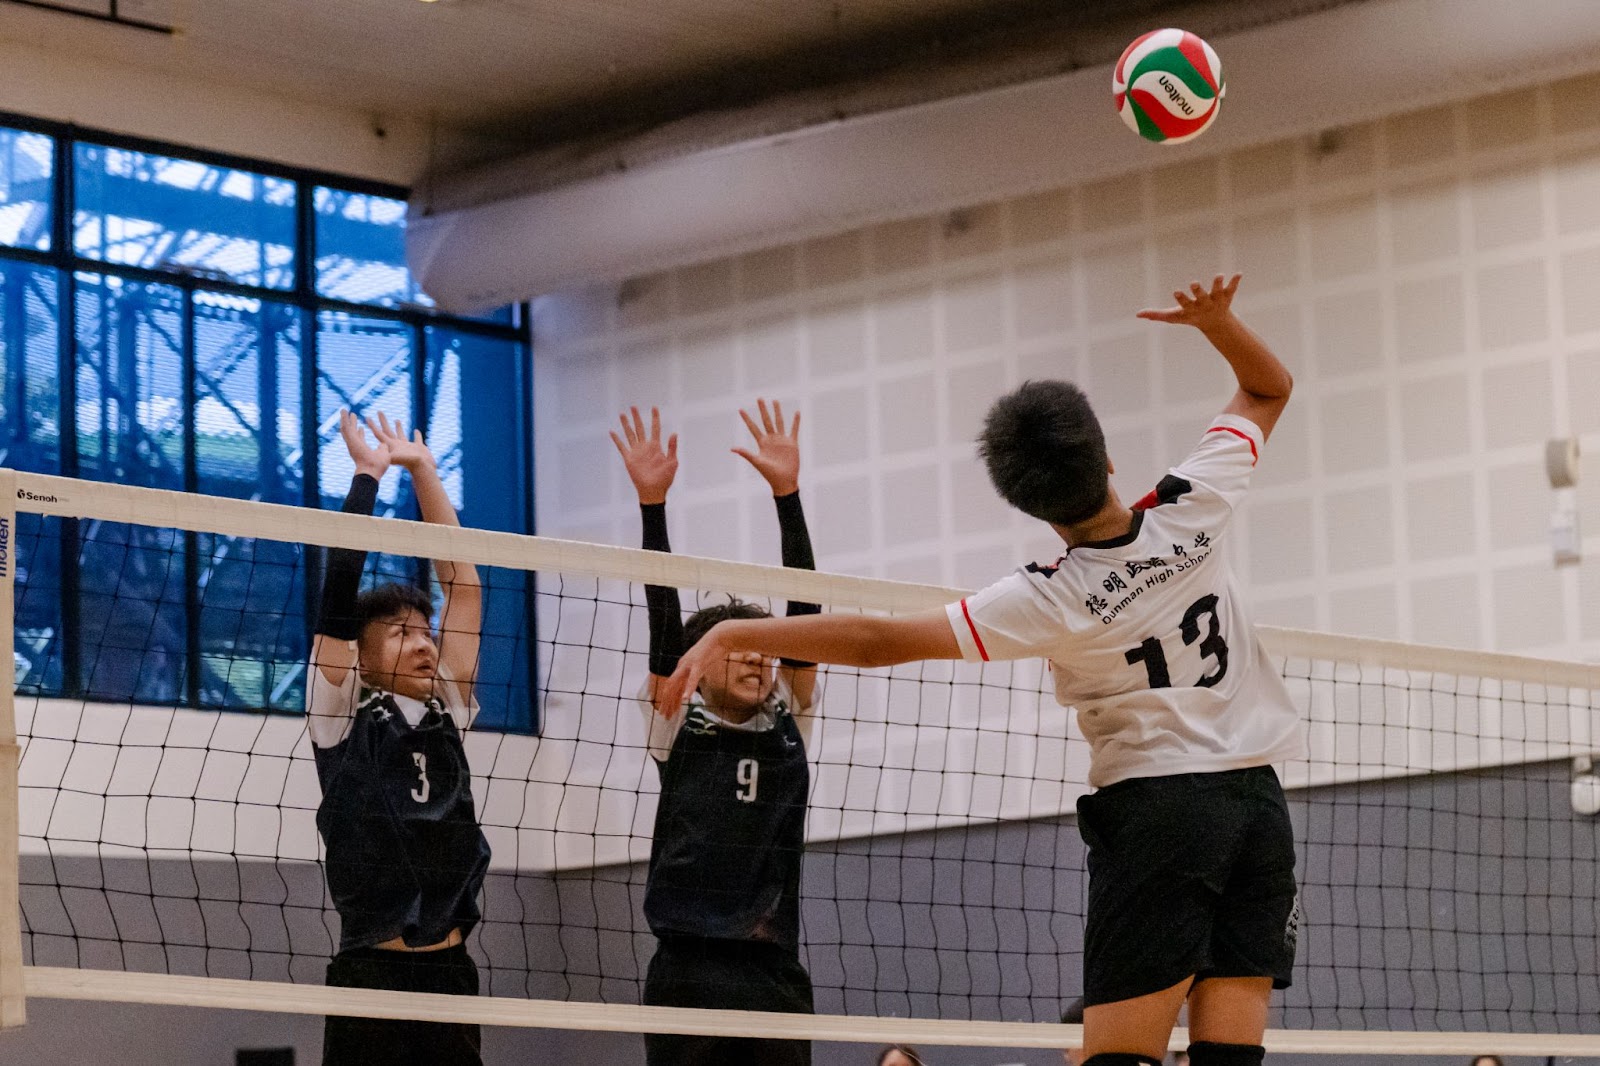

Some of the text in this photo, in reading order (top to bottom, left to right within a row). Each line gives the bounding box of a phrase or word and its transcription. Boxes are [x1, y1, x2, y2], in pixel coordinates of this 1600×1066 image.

[1159, 75, 1194, 115] molten
[26, 491, 58, 503] Senoh
[1102, 586, 1144, 625] Dunman
[1145, 568, 1174, 589] High
[1124, 593, 1229, 688] 13
[410, 752, 430, 803] 3
[736, 758, 759, 802] 9
